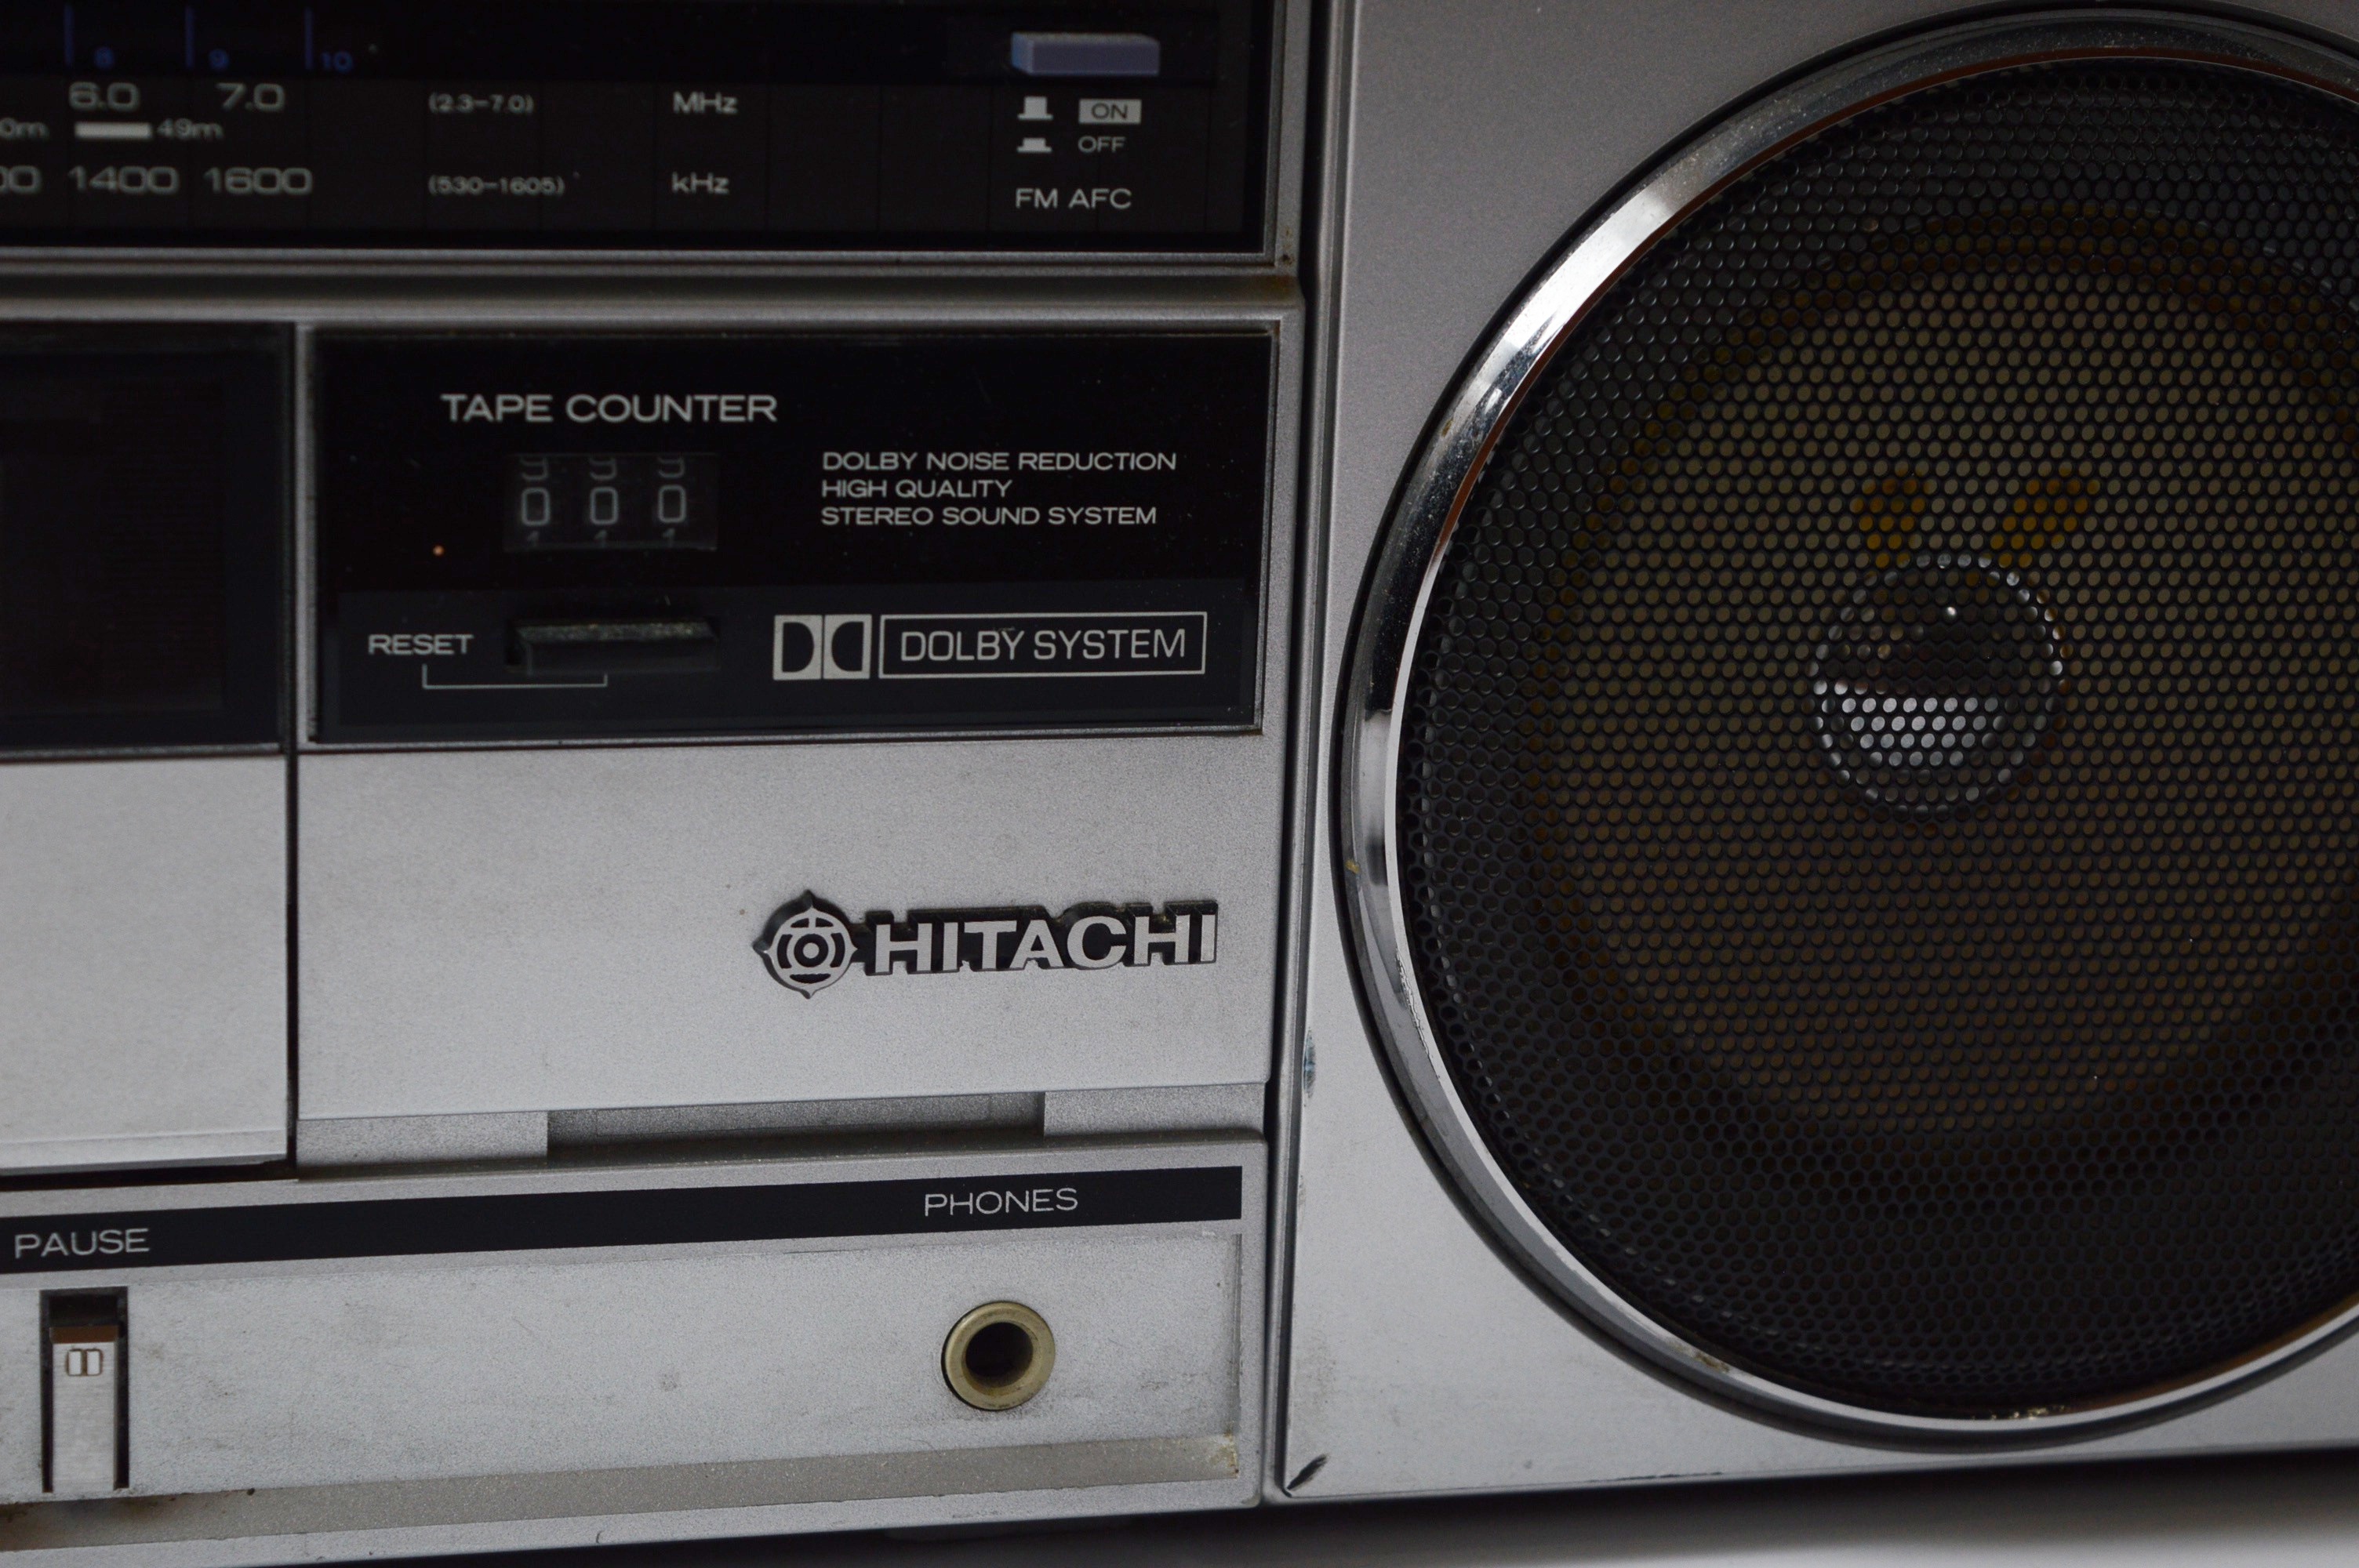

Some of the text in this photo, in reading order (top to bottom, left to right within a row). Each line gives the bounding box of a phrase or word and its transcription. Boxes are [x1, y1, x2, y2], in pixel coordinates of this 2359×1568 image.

[208, 48, 231, 71] 9
[320, 50, 354, 74] 10
[68, 82, 141, 111] 6.0
[216, 82, 285, 112] 7.0
[672, 93, 738, 115] MHz
[1090, 102, 1129, 121] ON
[158, 118, 224, 141] 49m
[1078, 136, 1125, 154] OFF
[67, 165, 180, 195] 1400
[203, 166, 313, 196] 1600
[671, 172, 729, 194] kHz
[1016, 187, 1132, 210] FM AFC
[441, 394, 778, 423] TAPE COUNTER
[823, 452, 1176, 471] DOLBY NOISE REDUCTION
[822, 479, 1012, 499] HIGH QUALITY
[821, 506, 1157, 525] STEREO SOUND SYSTEM
[368, 633, 474, 655] RESET
[900, 628, 1187, 662] DOLBY SYSTEM
[873, 913, 1216, 975] HITACHI
[924, 1188, 1078, 1217] PHONES
[14, 1228, 151, 1258] PAUSE
